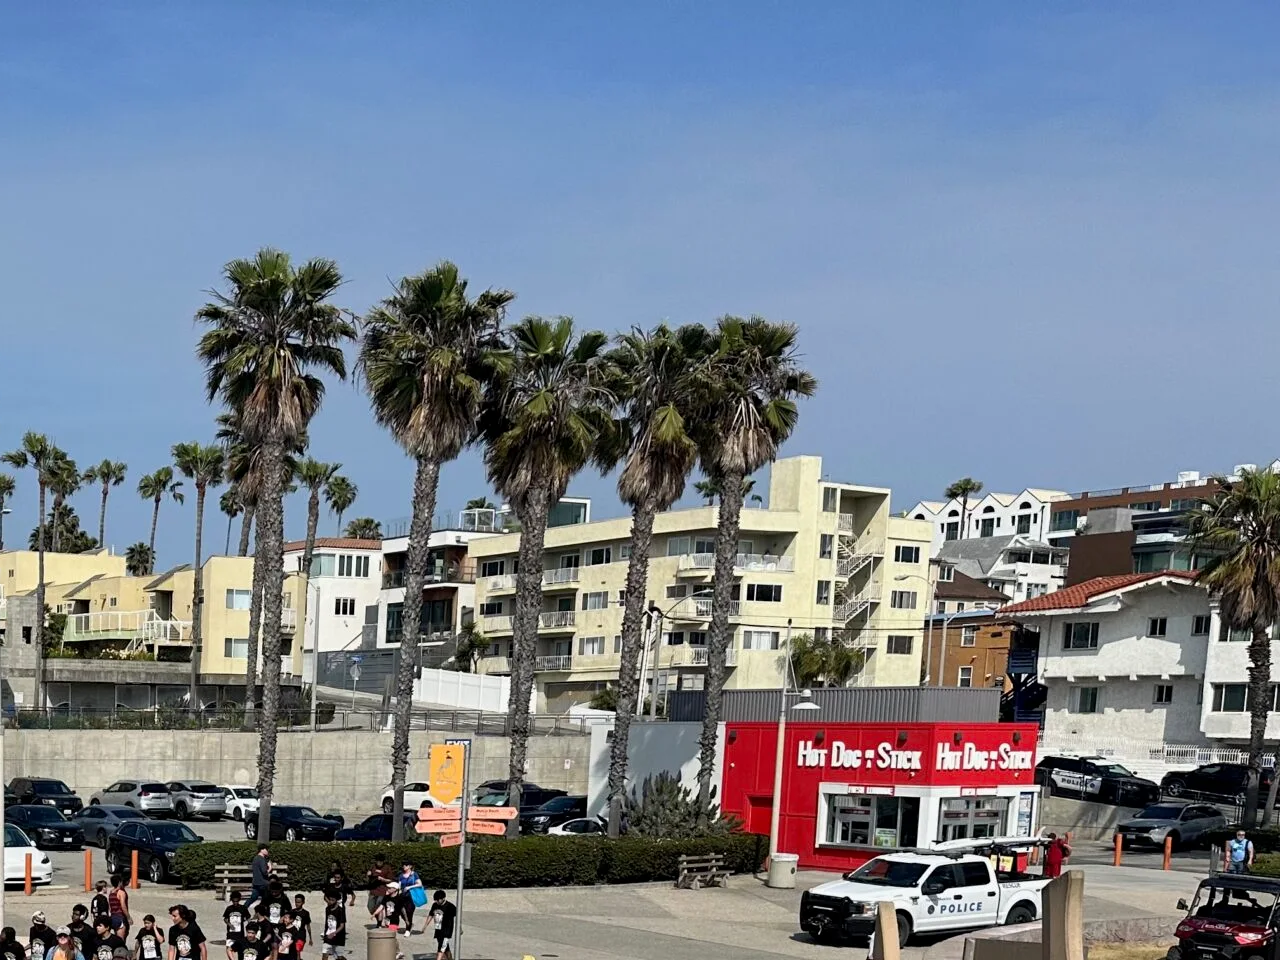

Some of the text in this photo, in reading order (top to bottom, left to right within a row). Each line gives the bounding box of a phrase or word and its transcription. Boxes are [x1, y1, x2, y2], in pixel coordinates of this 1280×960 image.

[797, 740, 828, 767] HOT
[876, 742, 922, 770] STICK
[935, 742, 962, 770] HOT
[998, 742, 1033, 770] STICK
[940, 901, 983, 914] POLICE
